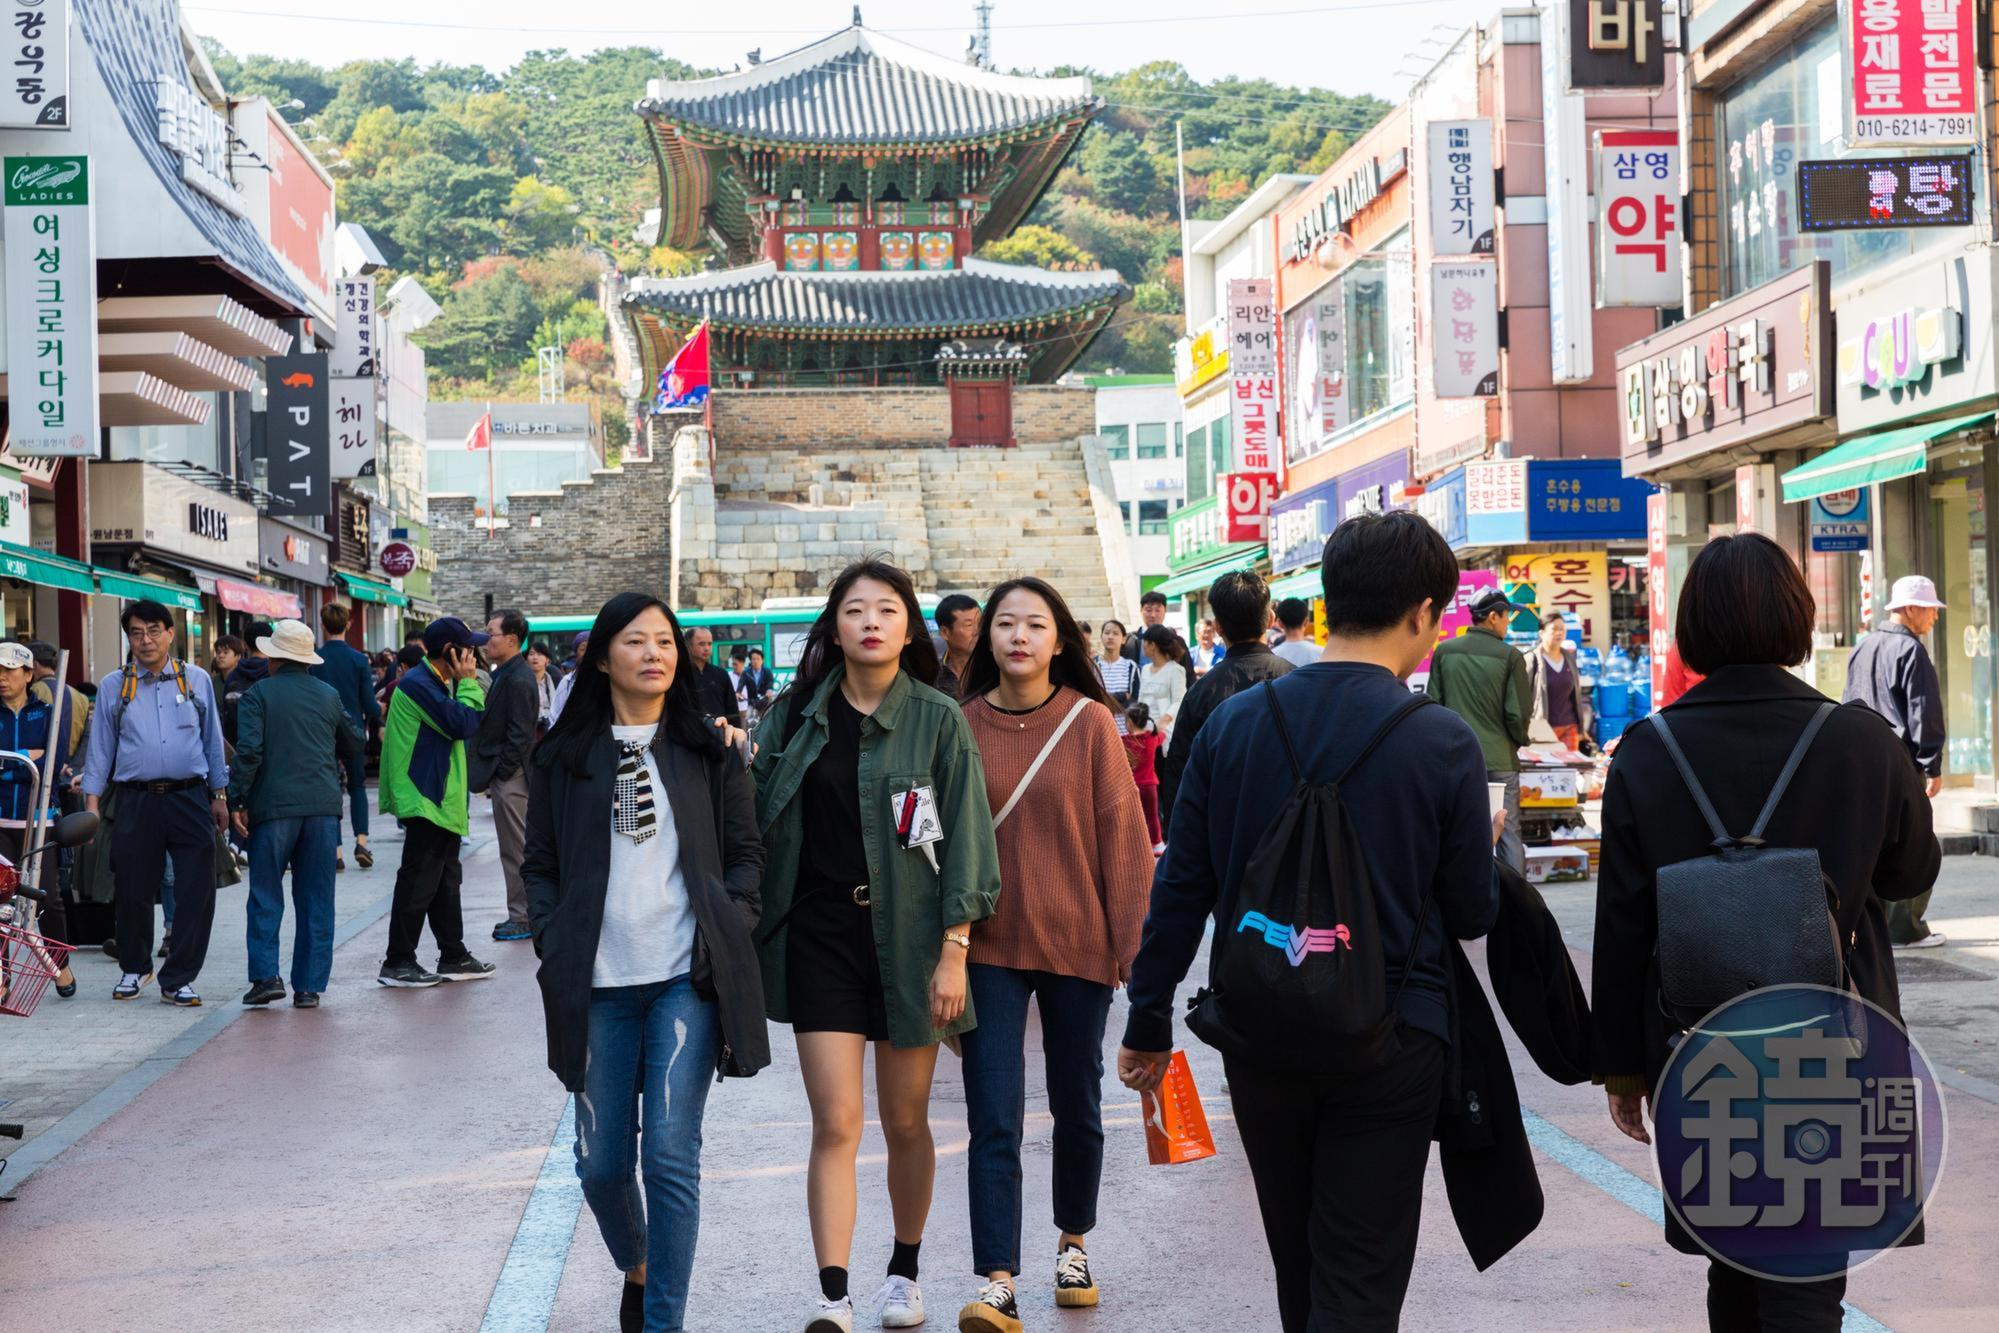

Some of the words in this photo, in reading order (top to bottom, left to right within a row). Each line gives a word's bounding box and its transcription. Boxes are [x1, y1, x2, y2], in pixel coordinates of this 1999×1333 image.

[47, 106, 62, 120] 2F
[1857, 117, 1972, 137] 010-6214-7991
[1613, 152, 1669, 180] 삼영
[20, 192, 74, 201] LADIES
[1448, 152, 1475, 240] 행남자기
[1480, 237, 1492, 249] 1F
[1607, 194, 1675, 273] 약
[33, 214, 66, 428] 여성크로커다일
[1235, 305, 1270, 323] 리안
[1235, 332, 1270, 350] 헤어
[1863, 312, 1910, 389] CU
[1653, 318, 1758, 430] 삼영약국
[1482, 381, 1496, 394] 1F
[288, 405, 312, 497] PAT
[1231, 478, 1274, 538] 약
[90, 528, 134, 541] 원남문점
[1820, 524, 1859, 535] KTRA
[1237, 910, 1352, 967] FEVER
